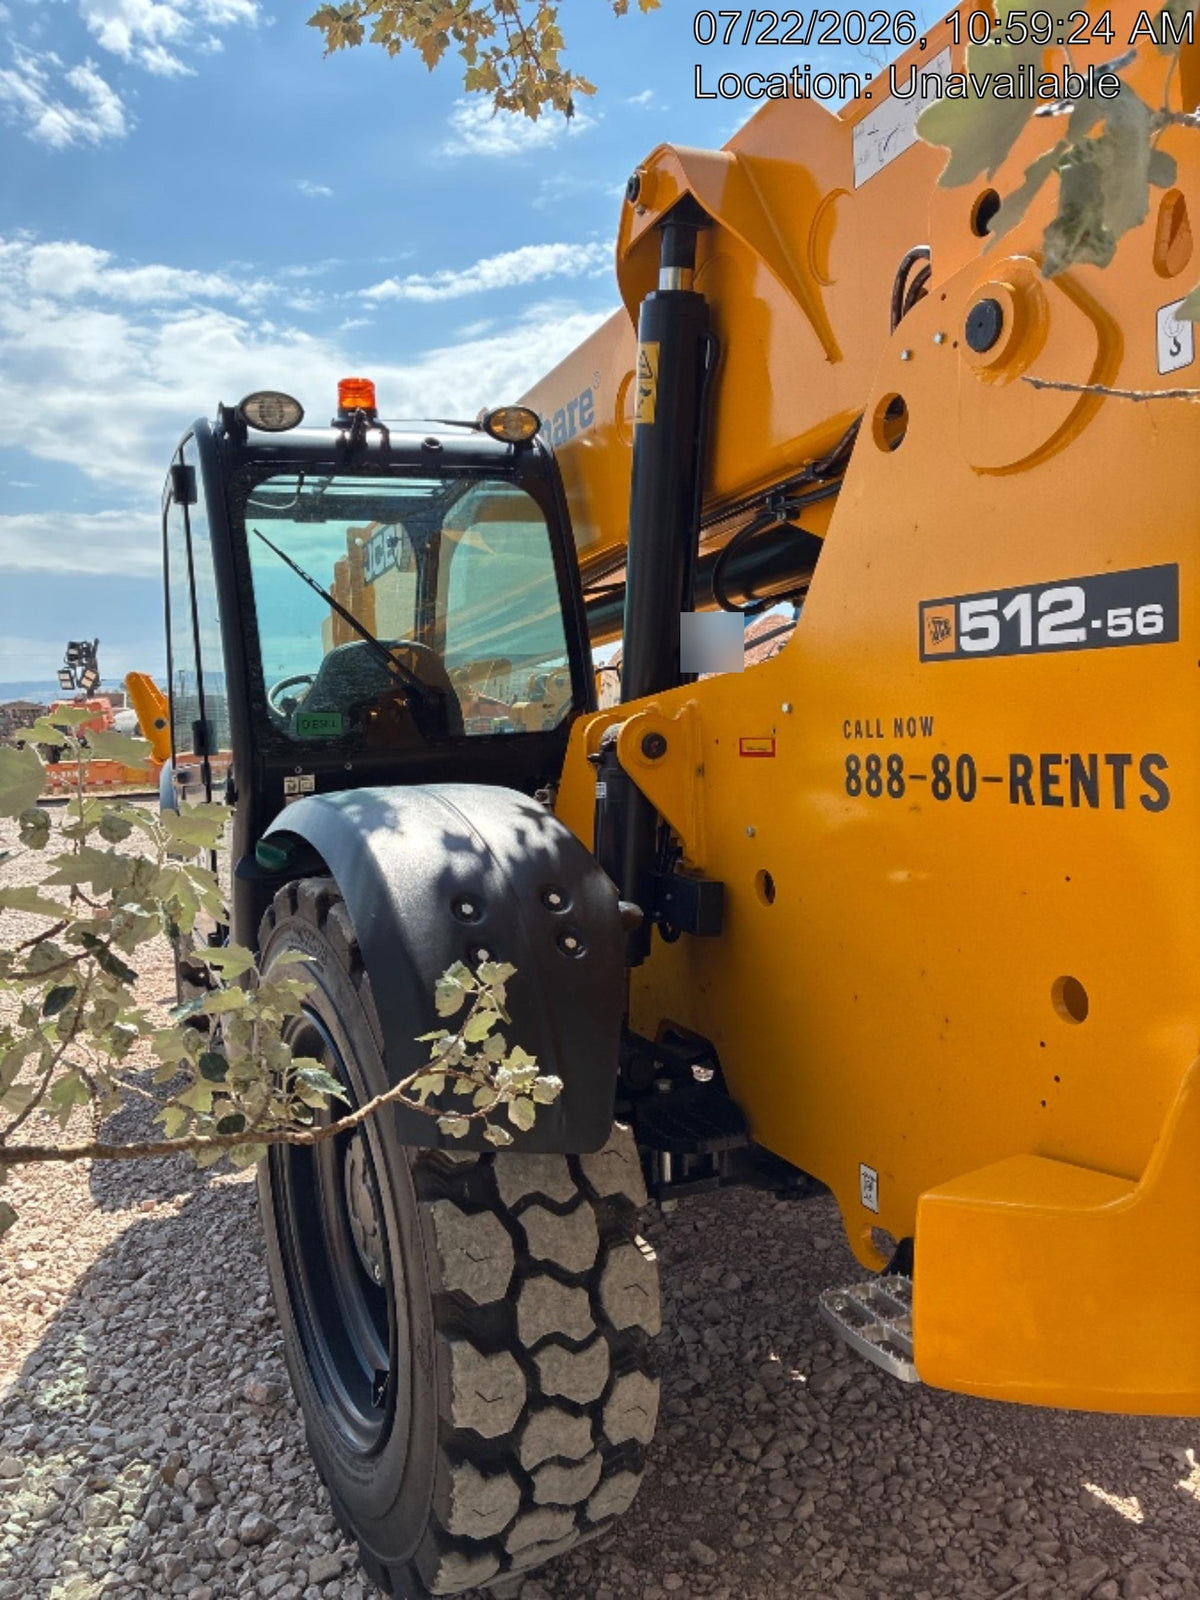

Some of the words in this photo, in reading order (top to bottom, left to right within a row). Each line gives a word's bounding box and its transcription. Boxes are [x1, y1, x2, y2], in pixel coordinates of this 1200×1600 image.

[843, 718, 884, 739] CALL
[893, 716, 934, 738] NOW
[845, 753, 1171, 813] 888-80-RENTS
